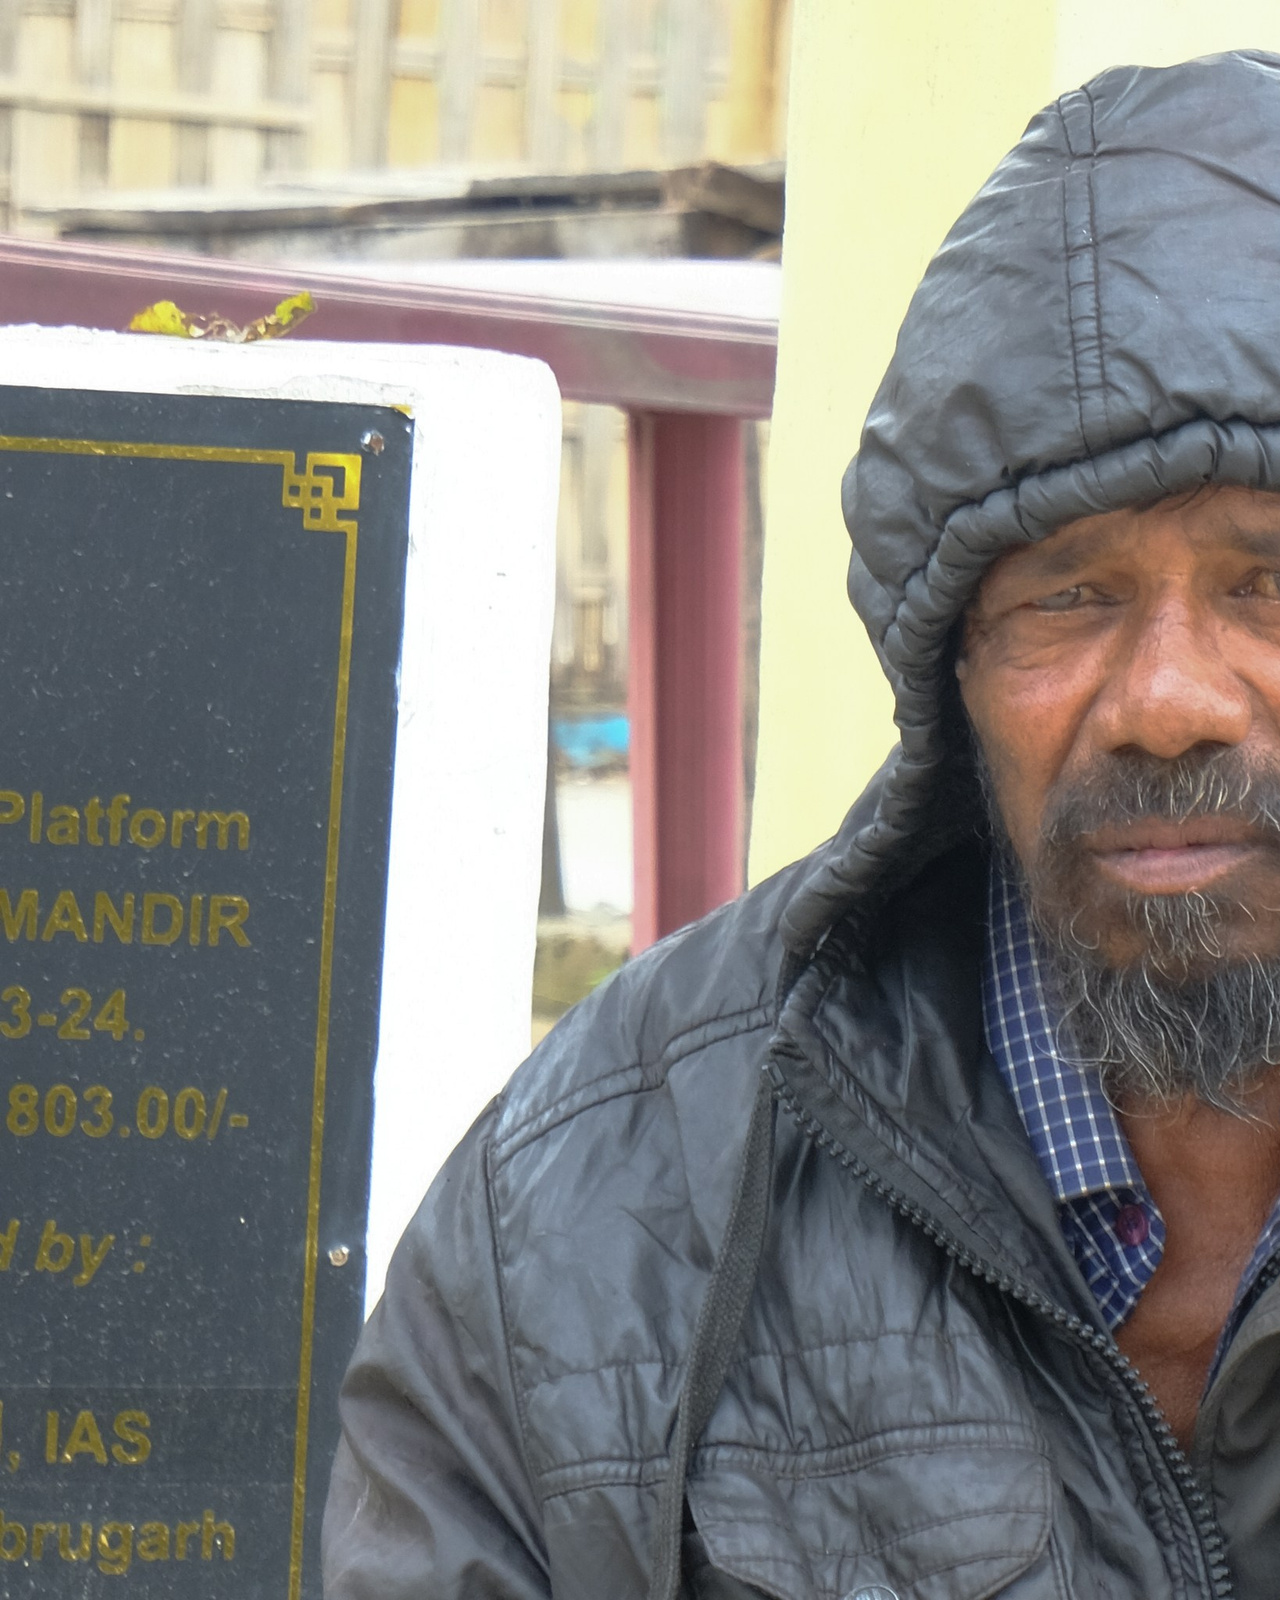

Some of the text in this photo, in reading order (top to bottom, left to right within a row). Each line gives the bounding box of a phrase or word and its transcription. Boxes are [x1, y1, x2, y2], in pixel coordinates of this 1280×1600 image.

[0, 789, 251, 851] Platform
[0, 887, 252, 948] MANDIR
[35, 1219, 116, 1287] by
[45, 1409, 152, 1466] IAS
